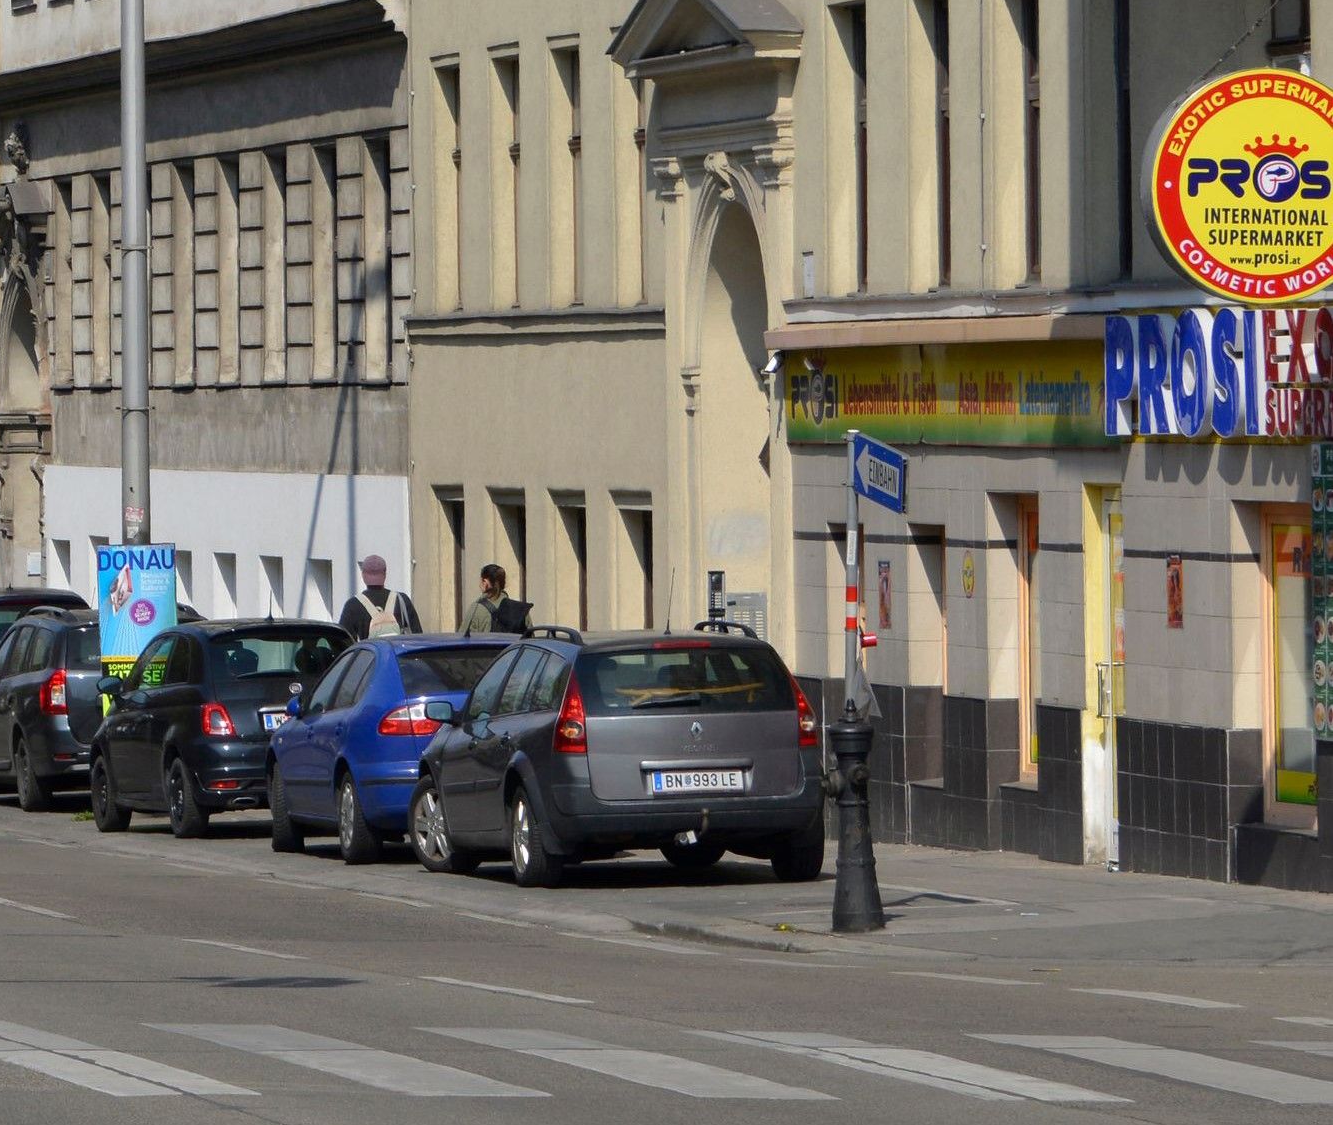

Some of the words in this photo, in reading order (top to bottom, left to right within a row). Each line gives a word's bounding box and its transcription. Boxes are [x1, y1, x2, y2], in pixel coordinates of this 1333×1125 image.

[1168, 91, 1226, 158] EXOTIC
[1204, 208, 1329, 226] INTERNATIONAL
[1208, 229, 1324, 247] SUPERMARKET
[1179, 238, 1276, 295] COSMETIC
[1230, 250, 1301, 267] www.prosi.at
[1104, 307, 1259, 438] PROSI
[842, 371, 900, 416] Lebensmittel
[1018, 370, 1091, 416] Lateinamerika
[868, 458, 898, 494] EINBAHN
[97, 549, 175, 571] DONAU
[665, 775, 683, 788] BN
[693, 773, 718, 787] 993
[721, 773, 737, 786] LE
